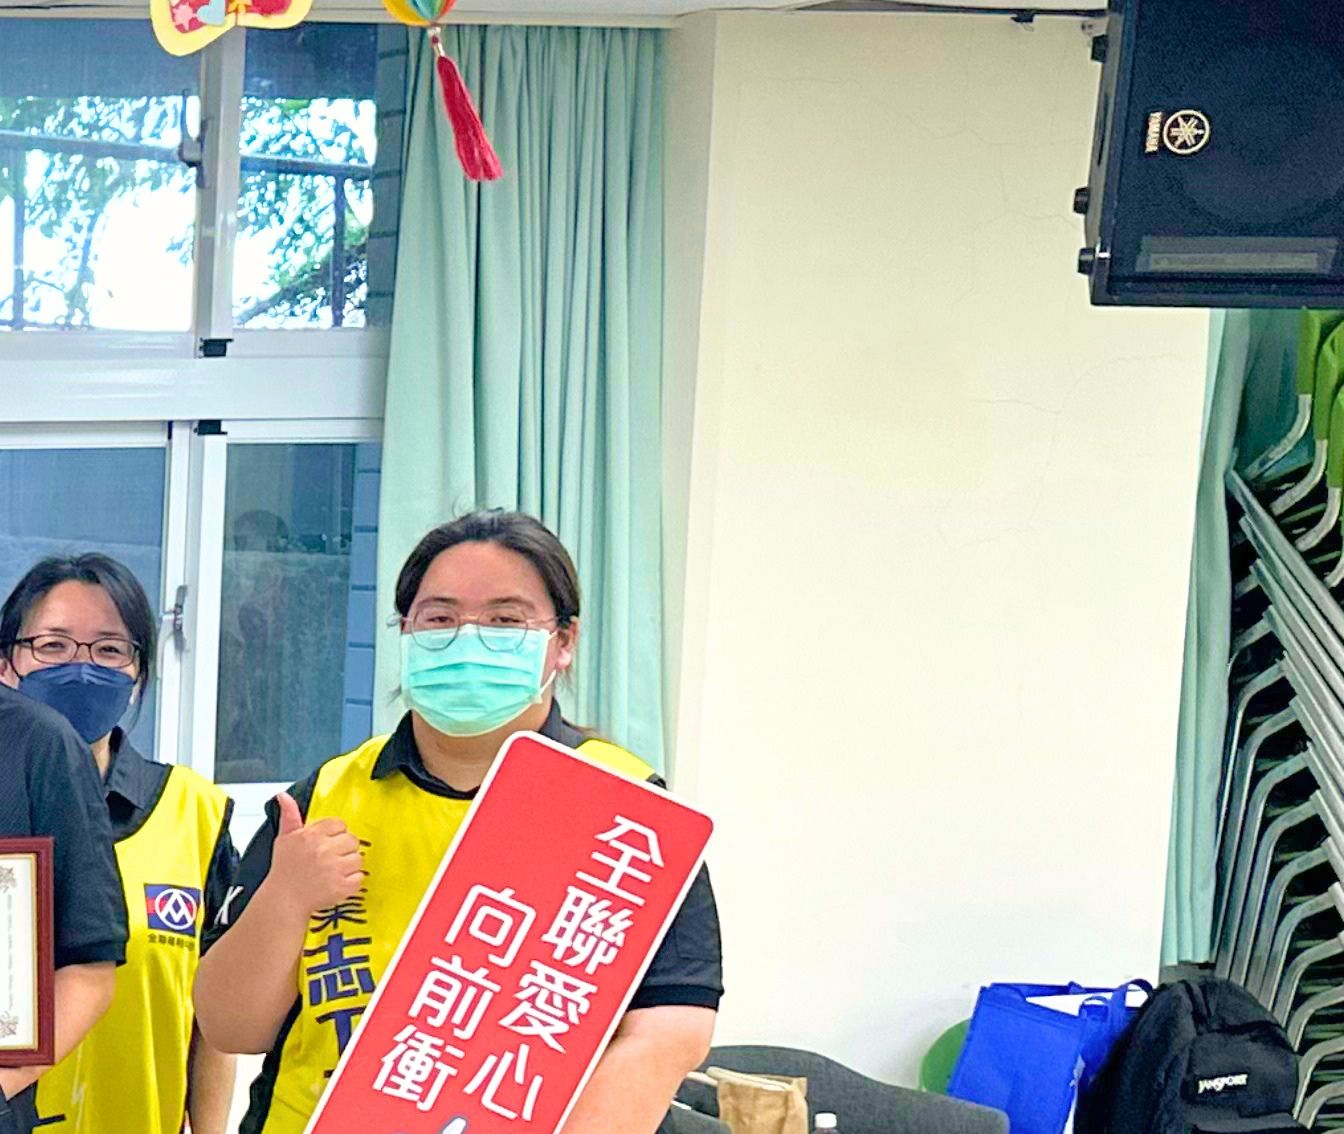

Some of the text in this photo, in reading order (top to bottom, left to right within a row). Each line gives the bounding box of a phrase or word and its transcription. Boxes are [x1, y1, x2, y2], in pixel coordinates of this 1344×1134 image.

[372, 884, 537, 1112] 向前衝
[464, 815, 665, 1121] 全聯愛心
